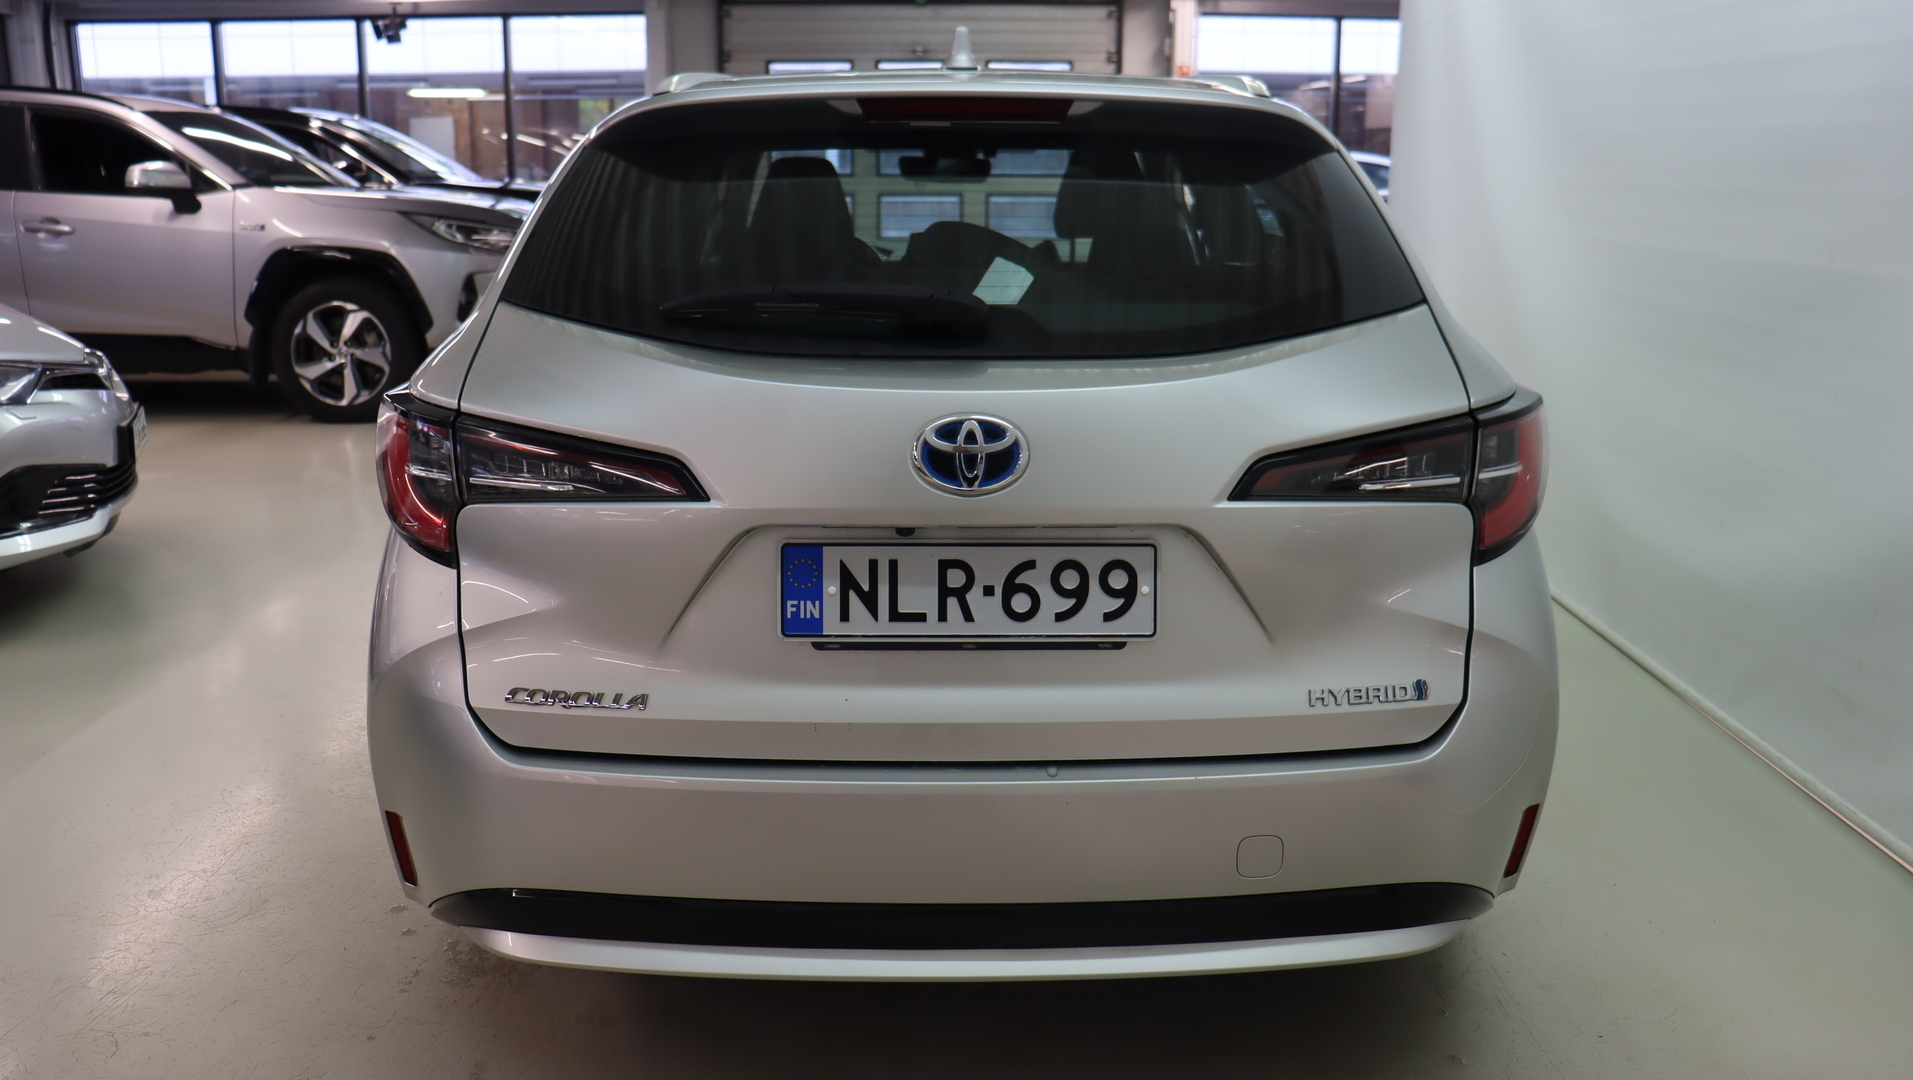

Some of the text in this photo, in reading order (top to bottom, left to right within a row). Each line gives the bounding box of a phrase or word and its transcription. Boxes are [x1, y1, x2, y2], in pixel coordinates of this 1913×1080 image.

[786, 600, 820, 619] FIN
[504, 687, 649, 711] COROLLA
[1308, 683, 1414, 707] HYBRID
